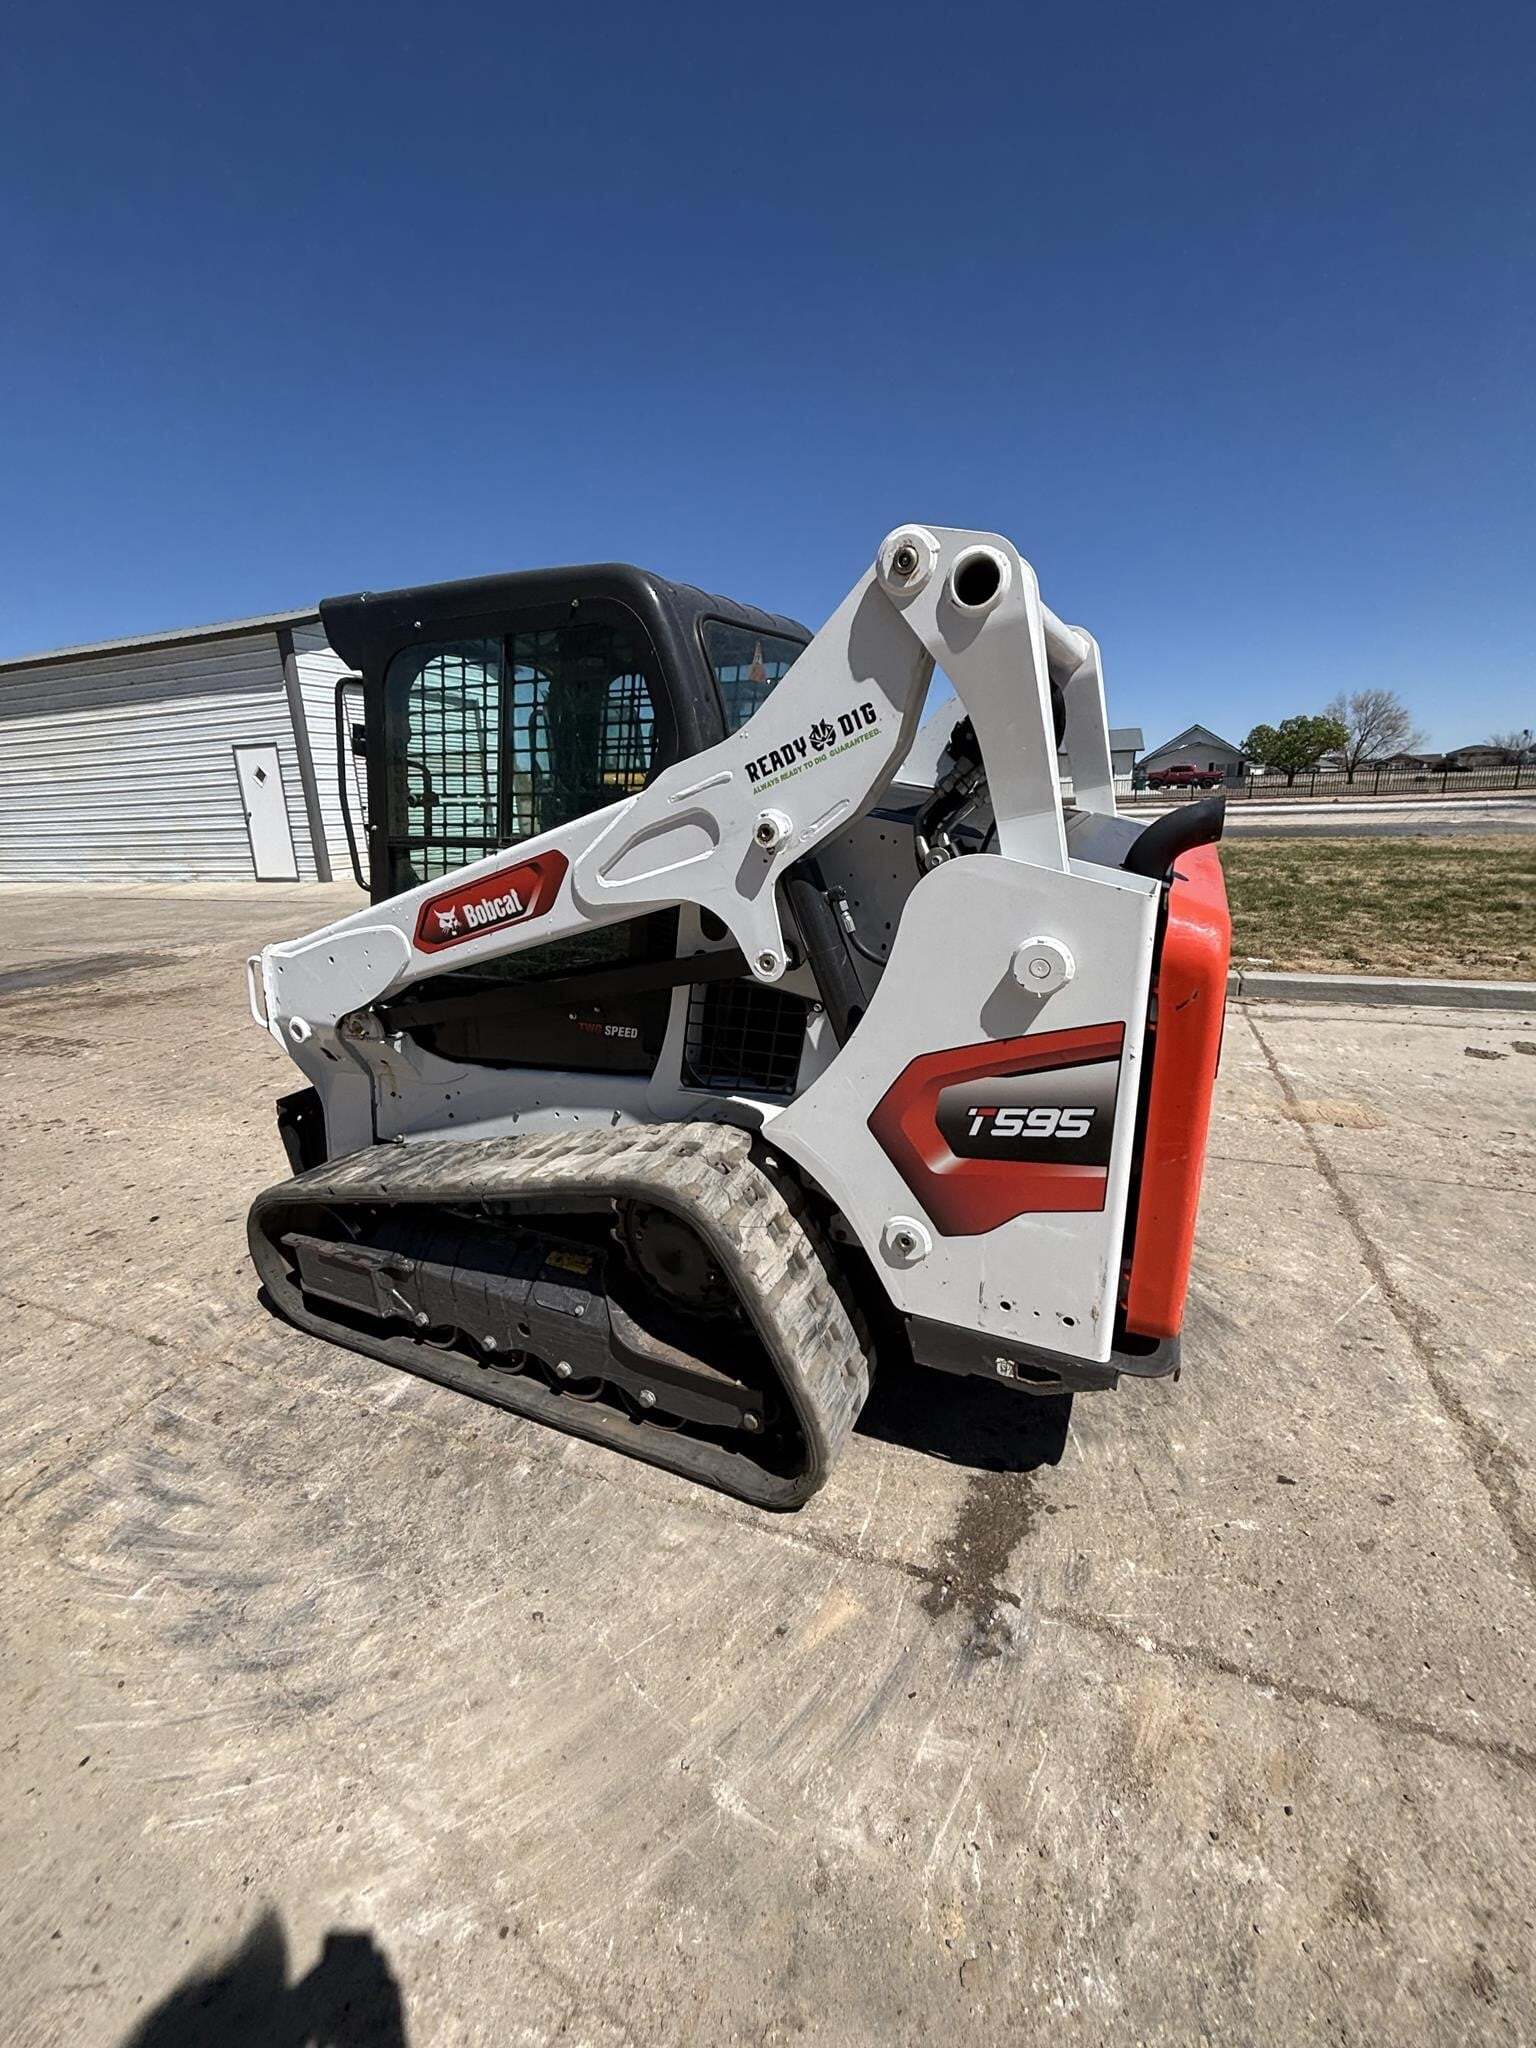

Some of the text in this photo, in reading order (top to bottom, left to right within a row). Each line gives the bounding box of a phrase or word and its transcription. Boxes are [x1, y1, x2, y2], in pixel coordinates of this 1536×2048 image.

[745, 702, 877, 783] READY DIG
[753, 776, 780, 795] ALWAYS
[780, 765, 803, 782] READY
[803, 759, 815, 770] TO
[814, 753, 828, 766] DIG
[462, 888, 524, 929] Bobcat
[604, 1025, 638, 1039] SPEED
[967, 1107, 1096, 1138] T595
